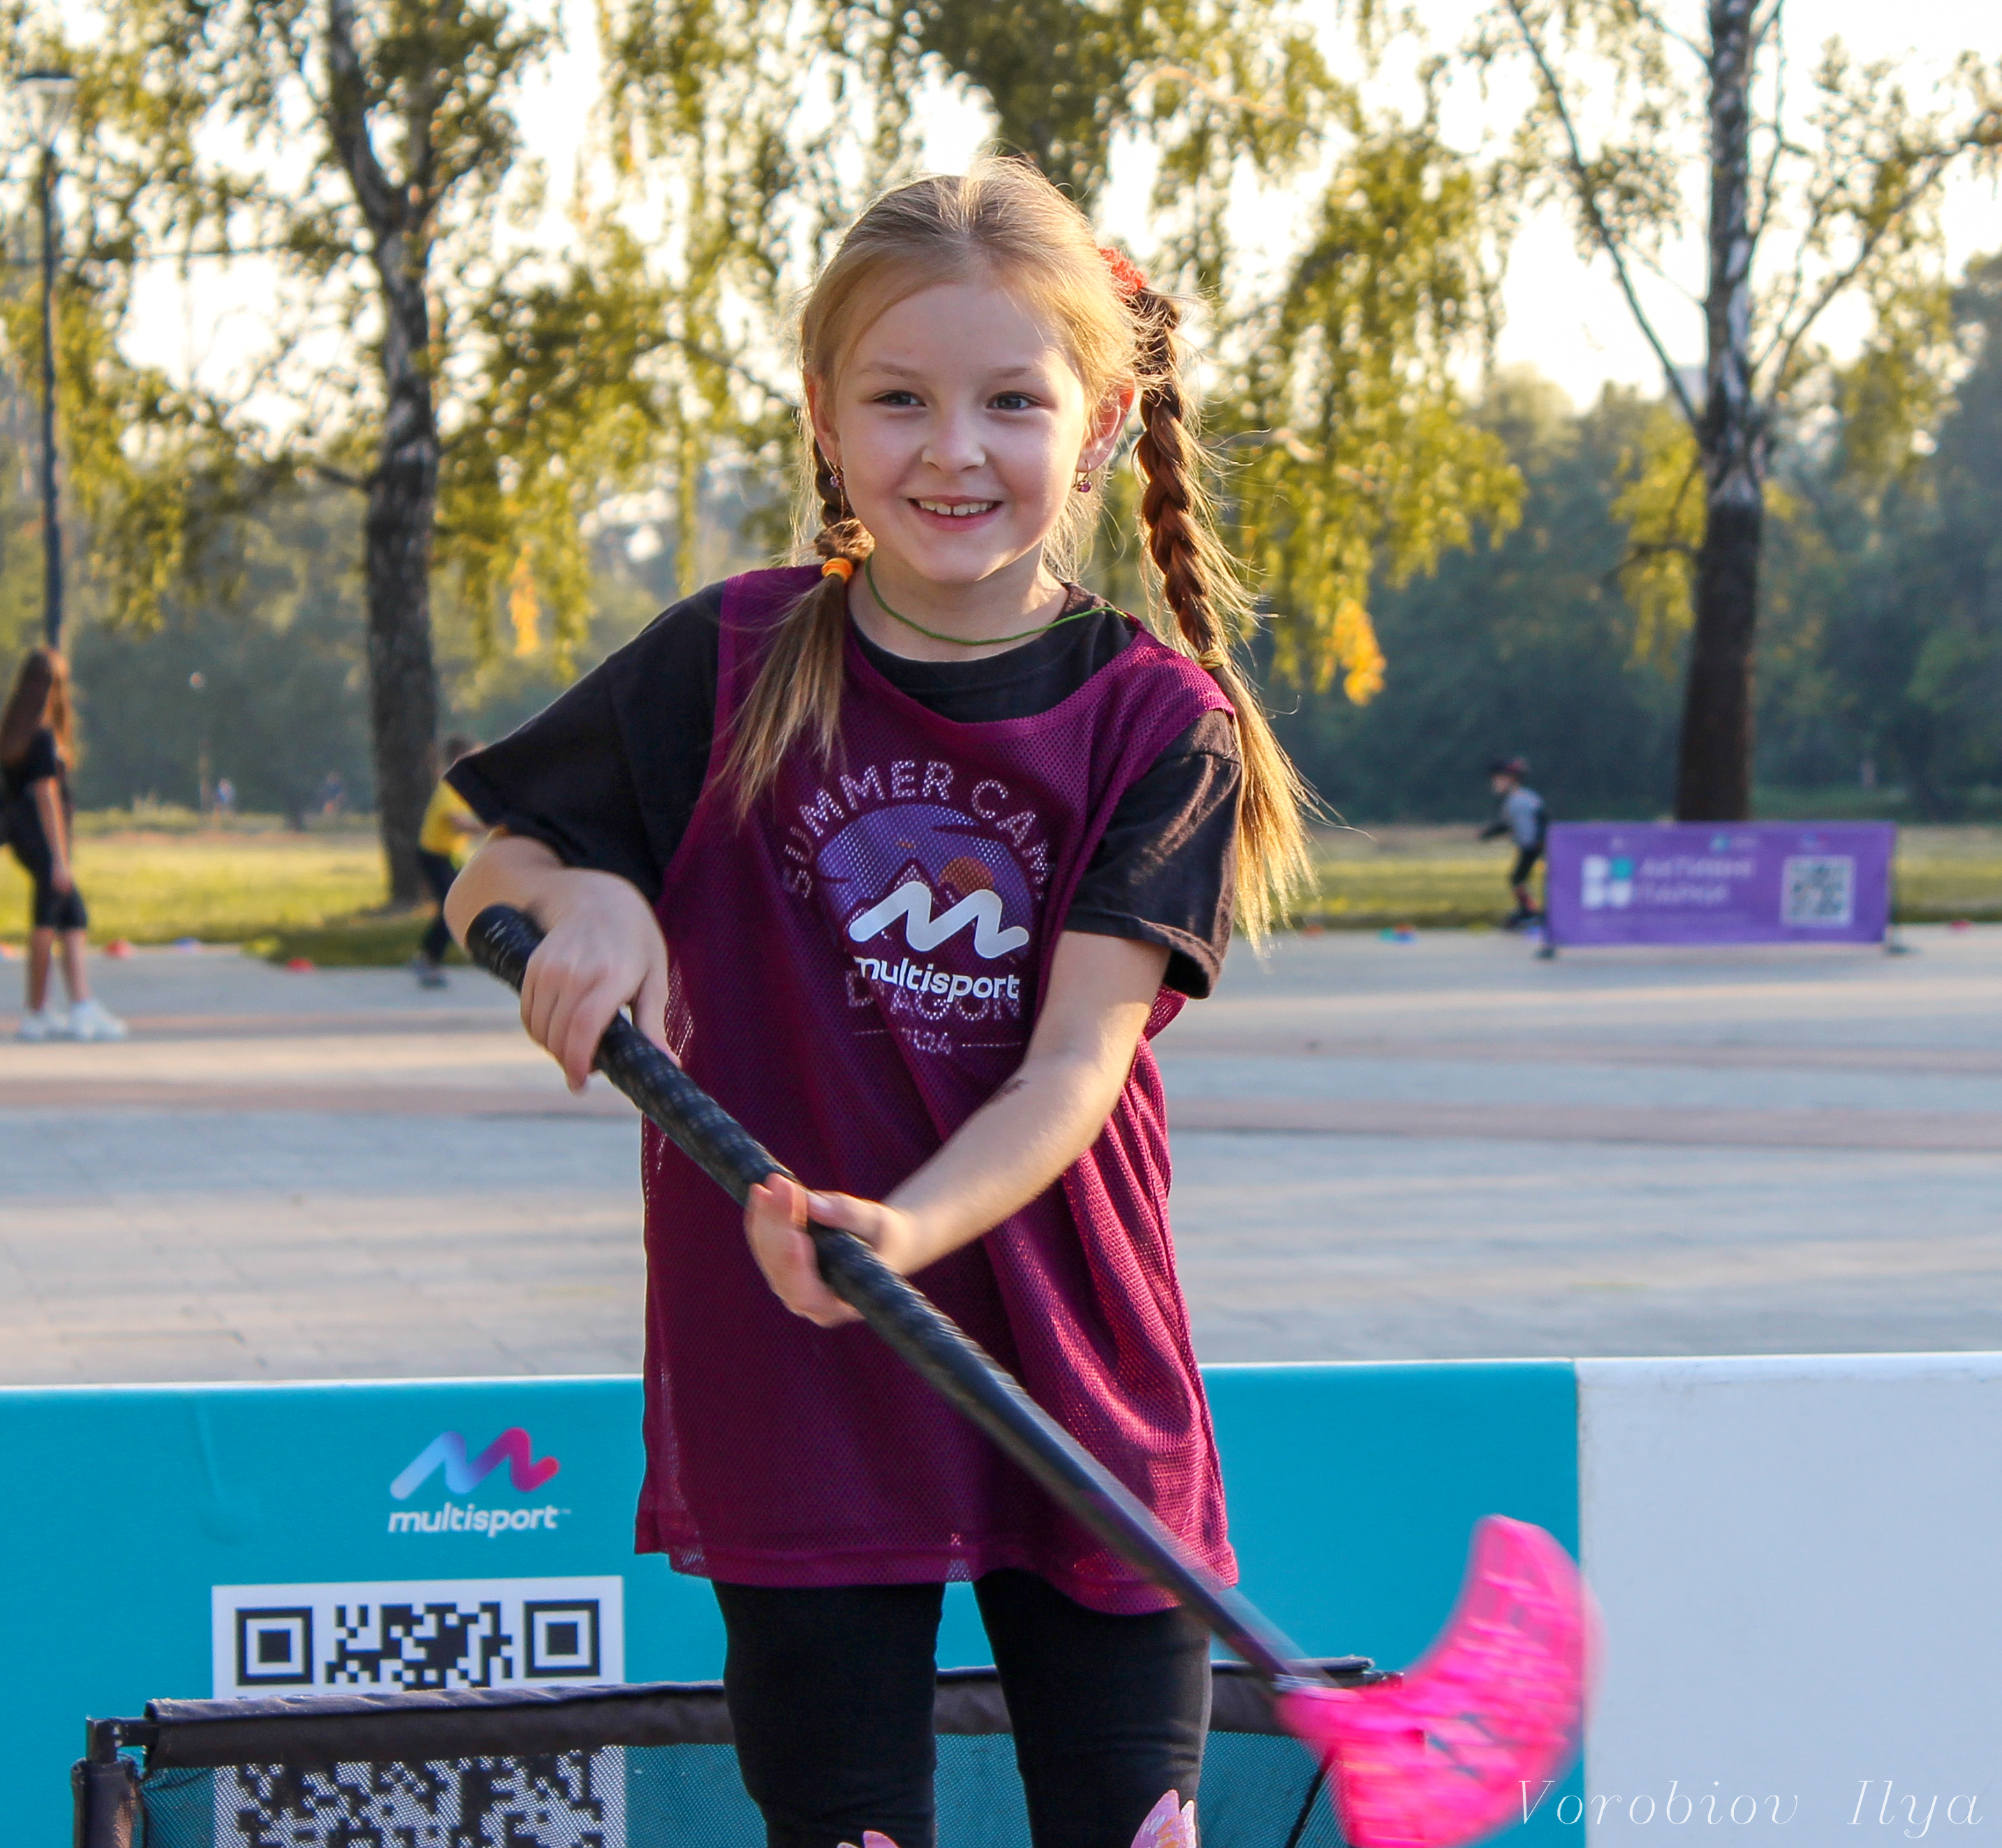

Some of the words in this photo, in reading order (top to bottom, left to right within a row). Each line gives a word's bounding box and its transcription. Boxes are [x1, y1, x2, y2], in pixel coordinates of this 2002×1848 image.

[782, 760, 955, 899] SUMMER
[971, 778, 1050, 900] CAM
[853, 956, 1020, 1003] multisport
[387, 1501, 559, 1538] multisport
